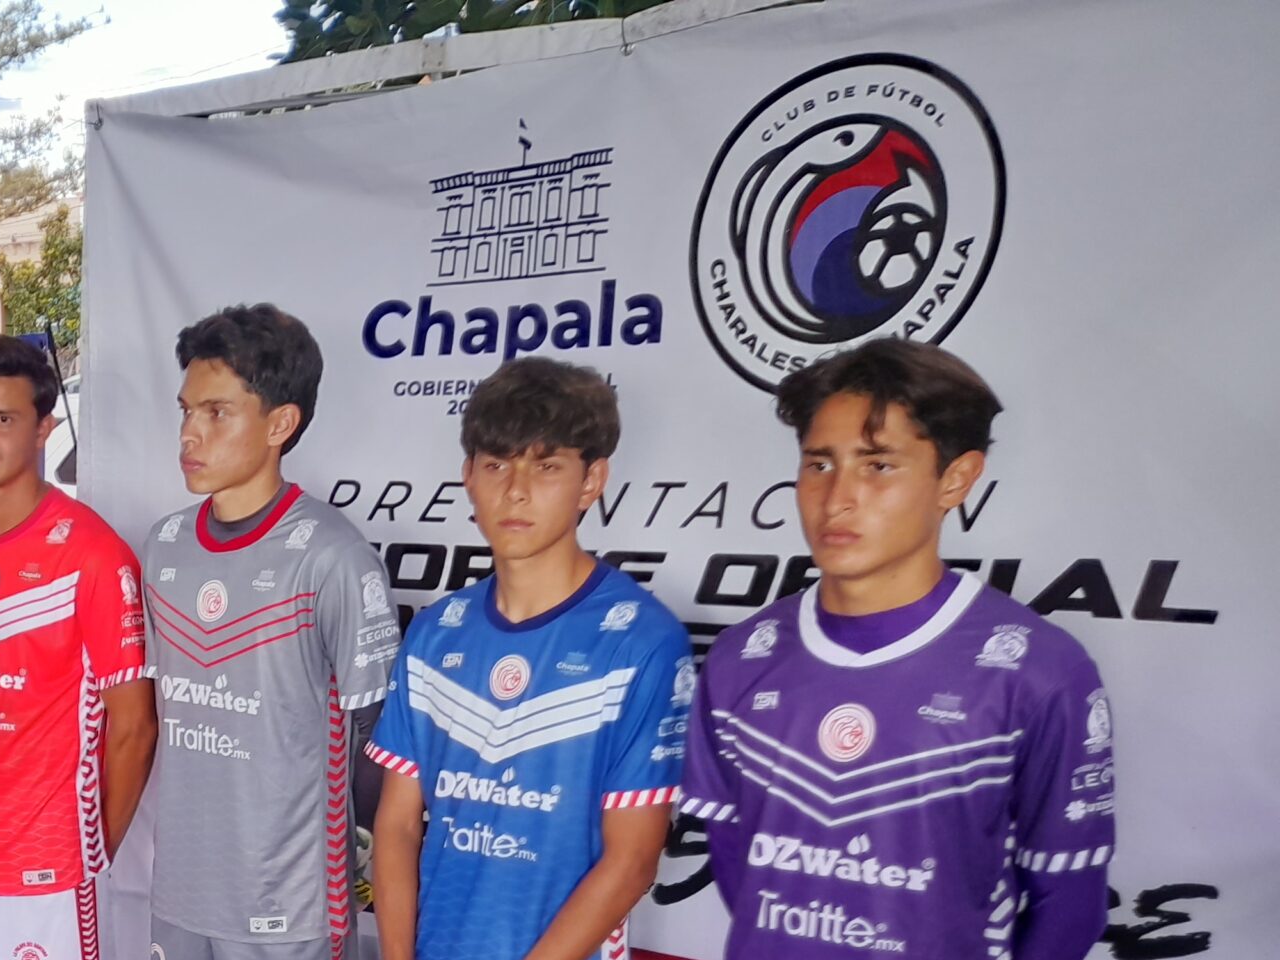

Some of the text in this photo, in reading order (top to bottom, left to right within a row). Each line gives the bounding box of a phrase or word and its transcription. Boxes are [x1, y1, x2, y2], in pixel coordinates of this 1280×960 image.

[761, 82, 946, 142] CLUB DE FÚTBOL
[362, 280, 663, 361] Chapala
[710, 235, 975, 373] CHARALES APALA
